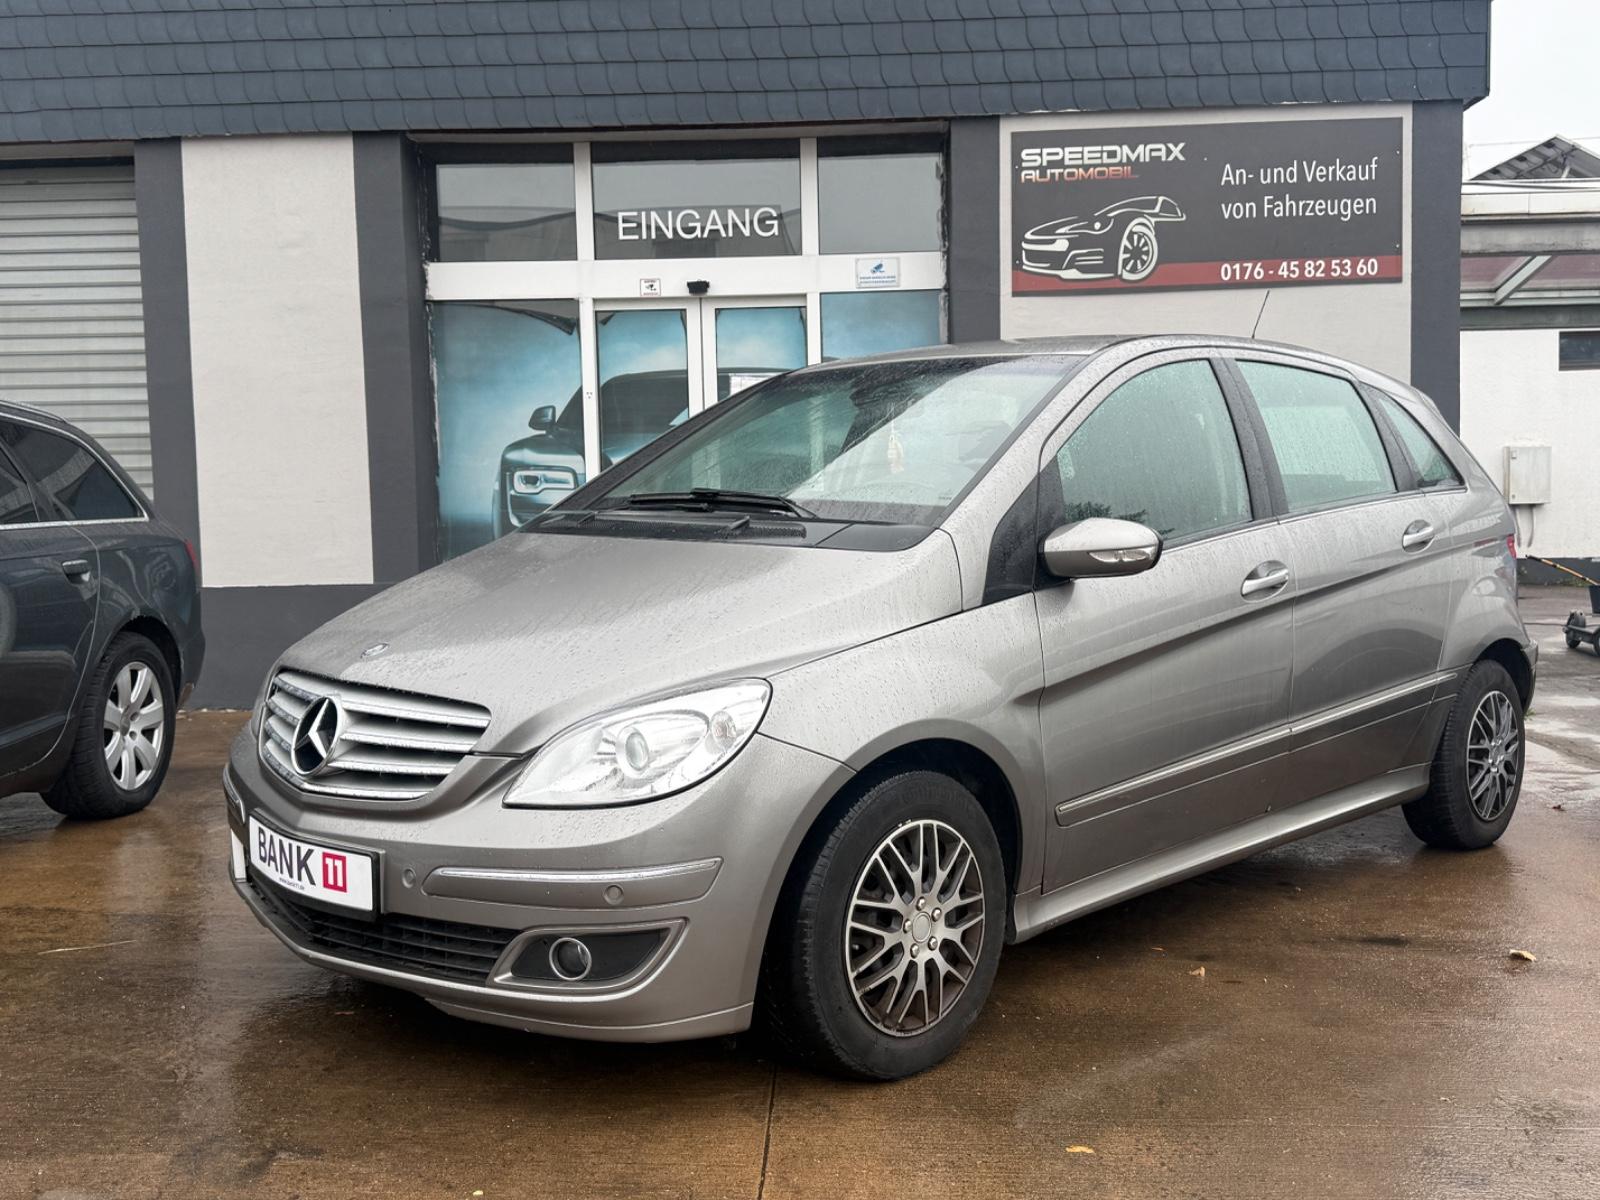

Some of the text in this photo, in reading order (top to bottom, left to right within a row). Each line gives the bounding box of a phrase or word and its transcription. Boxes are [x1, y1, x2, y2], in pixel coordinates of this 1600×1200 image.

[1020, 142, 1186, 168] SPEEDMAX
[1020, 165, 1139, 184] AUTOMOBIL
[1220, 156, 1379, 186] An- und Verkauf
[1221, 193, 1377, 222] von Fahrzeugen
[617, 206, 779, 241] EINGANG
[1220, 262, 1265, 281] 0176
[1278, 260, 1300, 279] 45
[1304, 260, 1326, 278] 82
[1330, 259, 1352, 277] 53
[1356, 258, 1379, 276] 60
[257, 826, 344, 889] BANK 11
